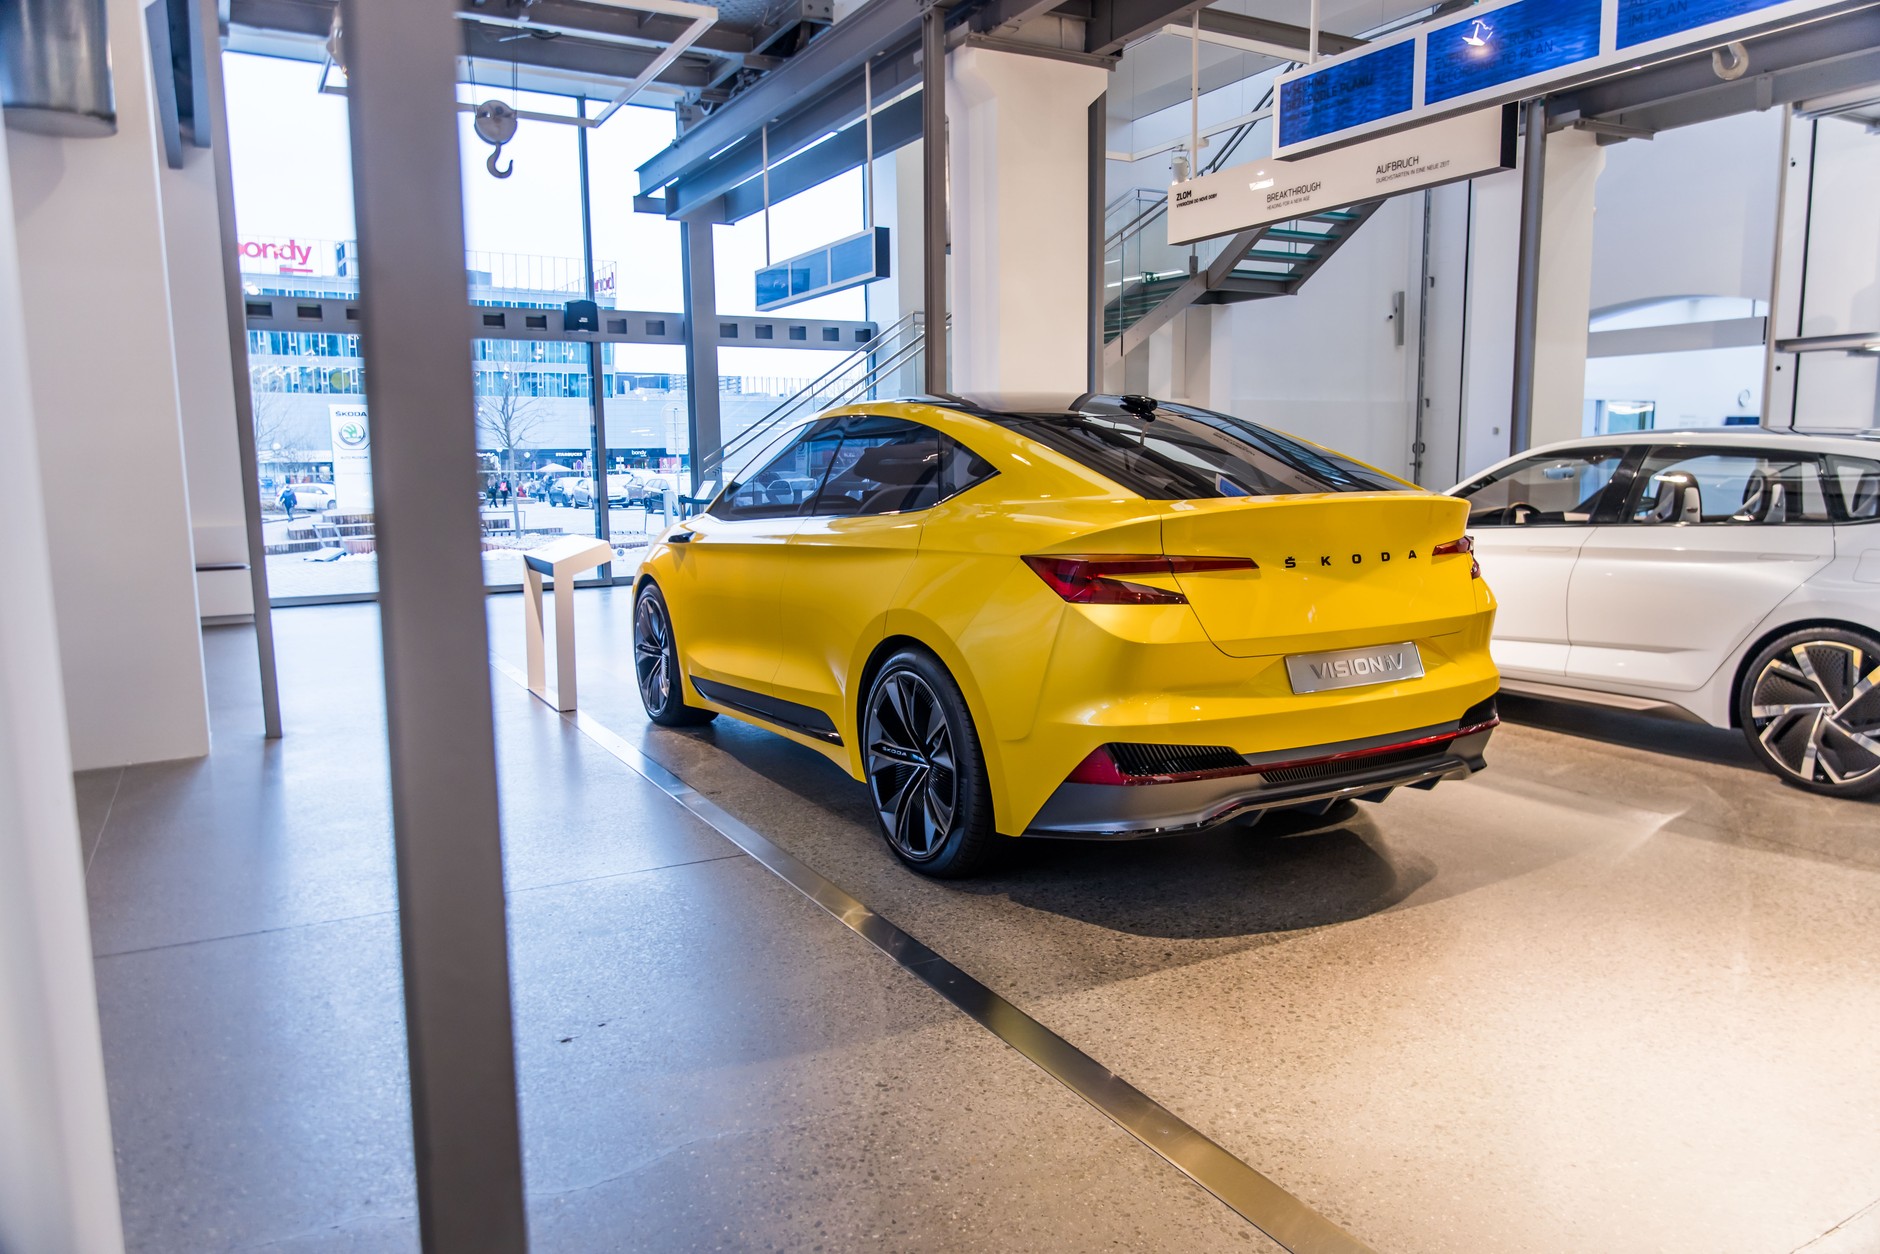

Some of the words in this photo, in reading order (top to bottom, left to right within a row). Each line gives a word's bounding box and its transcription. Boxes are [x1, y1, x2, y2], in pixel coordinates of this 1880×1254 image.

[1648, 0, 1688, 22] PLAN
[1520, 40, 1553, 60] PLAN
[1376, 155, 1420, 175] AUFBRUCH
[1376, 170, 1409, 184] DURCHSTARTEN
[1416, 165, 1426, 174] EINE
[1427, 162, 1439, 171] NEUE
[1440, 159, 1450, 169] ZEIT
[1176, 189, 1192, 201] ZLOM
[1266, 180, 1321, 203] BREAKTHROUGH
[1284, 550, 1417, 568] ŠKODA
[1310, 657, 1384, 679] VISION
